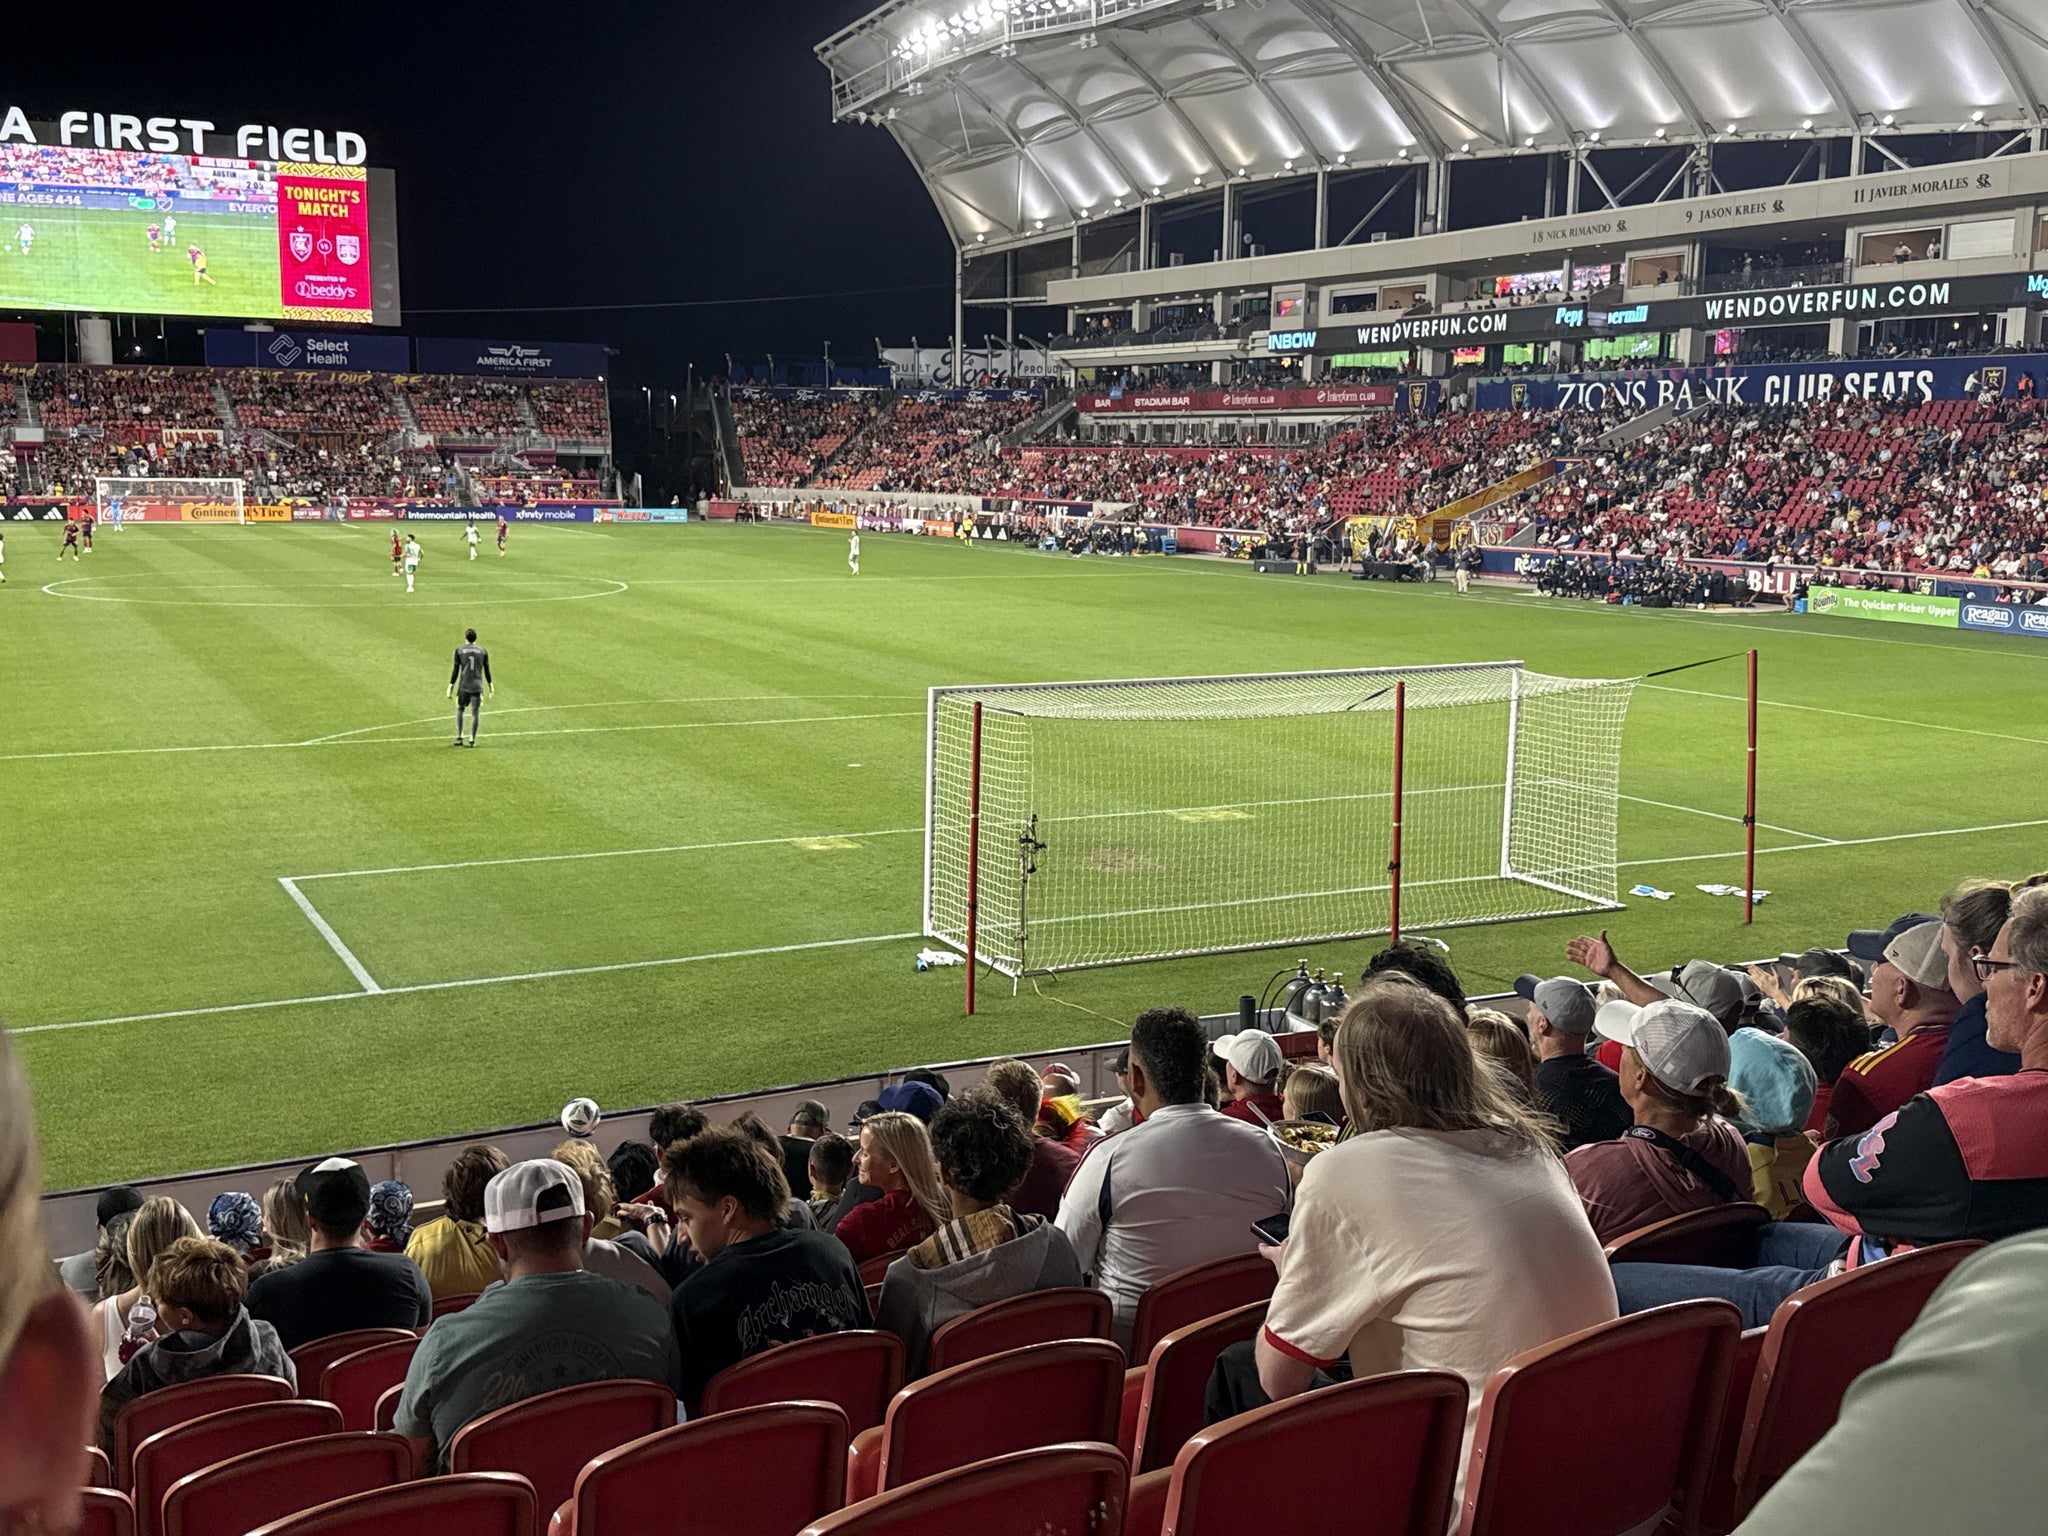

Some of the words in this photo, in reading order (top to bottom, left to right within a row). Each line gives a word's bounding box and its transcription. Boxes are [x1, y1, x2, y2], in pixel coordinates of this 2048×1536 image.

[60, 111, 215, 155] FIRST
[237, 124, 367, 166] FIELD
[284, 186, 361, 204] TONIGHT'S
[1854, 189, 1865, 203] 11
[1868, 185, 1908, 202] JAVIER
[1911, 177, 1969, 194] MORALES
[18, 194, 54, 204] AGES
[55, 195, 82, 205] 4-14
[228, 202, 278, 213] EVERYO
[298, 202, 349, 218] MATCH
[1685, 210, 1693, 223] 9
[1699, 206, 1733, 223] JASON
[1735, 202, 1767, 216] KREIS
[1532, 230, 1544, 243] 18
[1546, 228, 1567, 240] NICK
[1569, 223, 1611, 238] RIMANDO
[311, 284, 357, 300] beddy's
[1705, 282, 1950, 320] WENDOVERFUN.COM
[307, 338, 349, 352] Select
[307, 352, 348, 365] Health
[476, 356, 522, 367] AMERICA
[523, 358, 553, 368] FIRST
[1327, 390, 1358, 403] Interform
[1359, 392, 1375, 400] CLUB
[1557, 380, 1646, 411] ZIONS
[1658, 376, 1748, 409] BANK
[1764, 373, 1834, 406] CLUB
[1843, 370, 1933, 404] SEATS
[1094, 399, 1111, 407] BAR
[1134, 397, 1171, 406] STADIUM
[1172, 396, 1190, 405] BAR
[1260, 396, 1274, 404] CLUB
[260, 508, 284, 518] Tire
[408, 511, 467, 519] Intermountain
[468, 511, 496, 520] Health
[515, 510, 544, 520] xfinity
[545, 510, 576, 519] mobile
[1045, 506, 1069, 518] LAKE
[1813, 595, 1838, 610] Bounty
[1843, 597, 1860, 608] The
[1861, 599, 1896, 610] Quicker
[1898, 602, 1926, 614] Picker
[1928, 604, 1958, 618] Upper
[1967, 607, 2008, 623] Reagan
[468, 655, 475, 670] 1
[738, 1281, 856, 1355] Archangel
